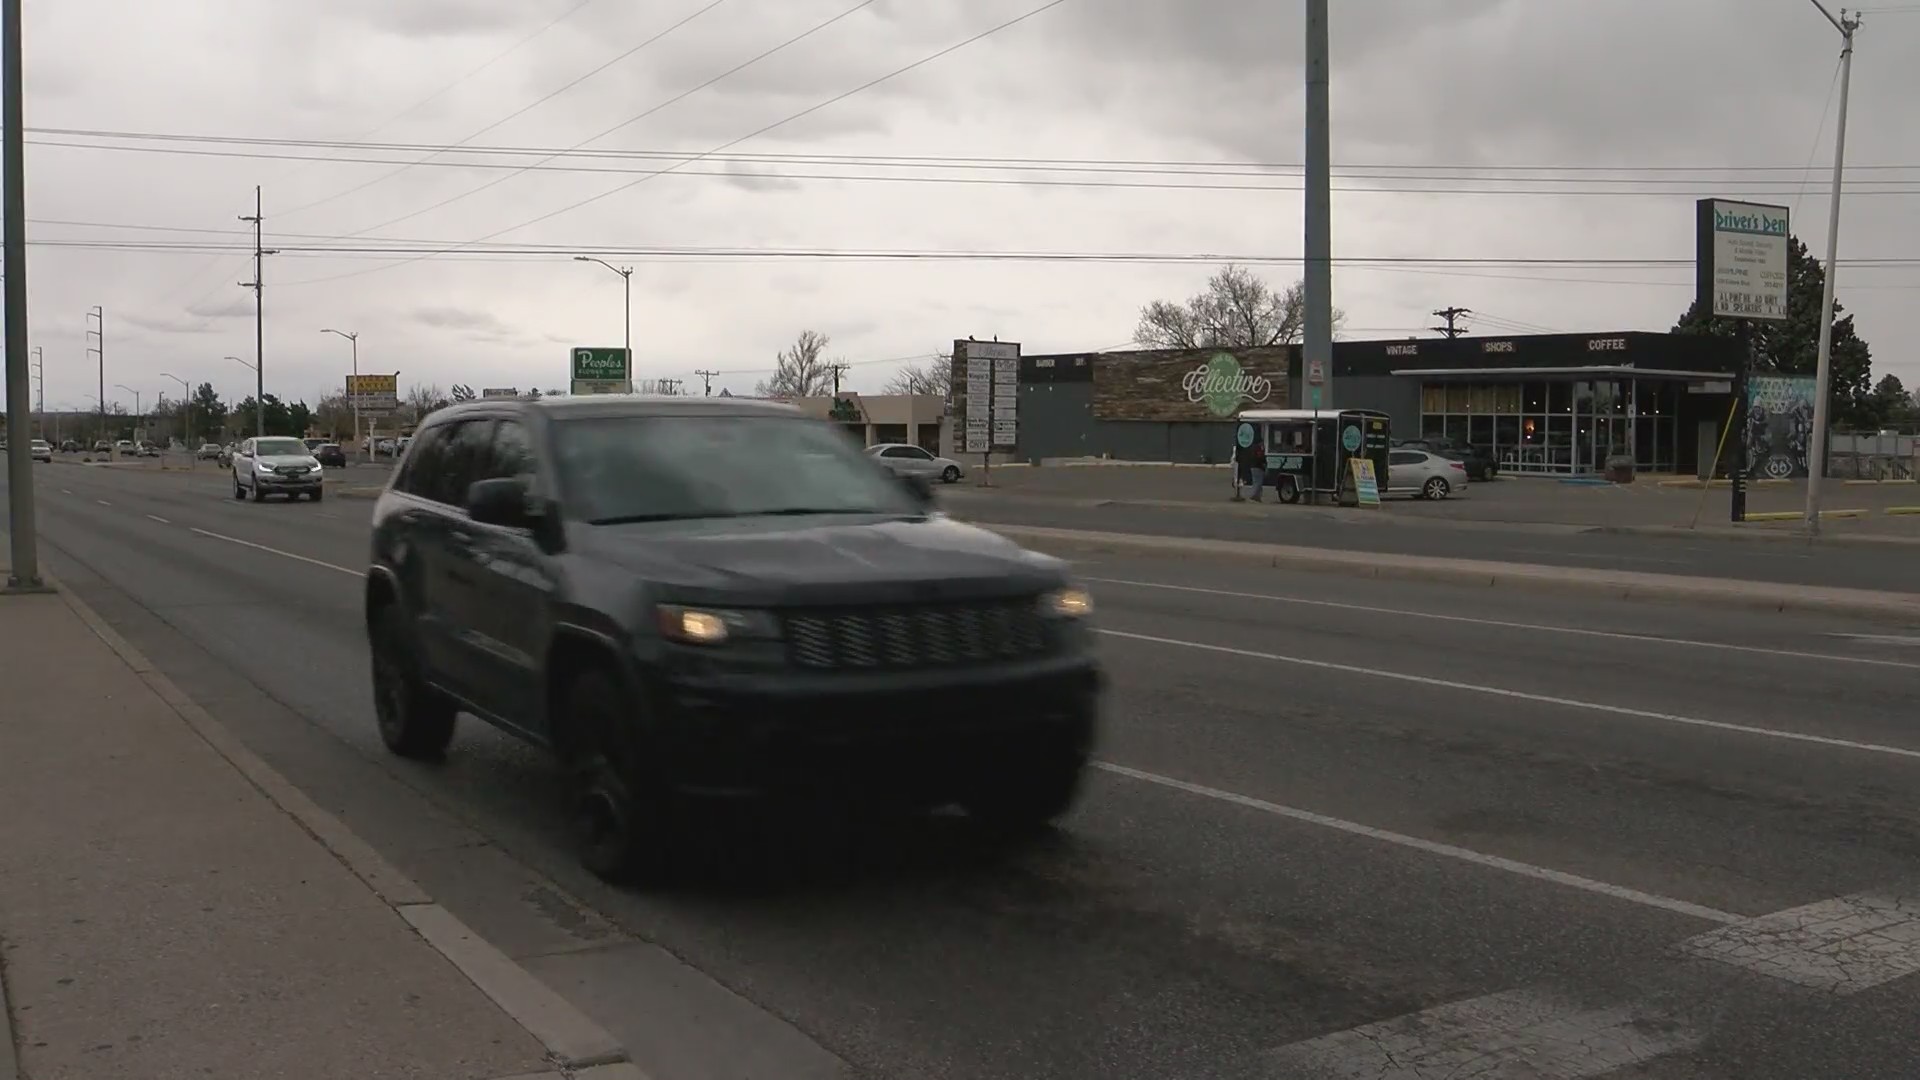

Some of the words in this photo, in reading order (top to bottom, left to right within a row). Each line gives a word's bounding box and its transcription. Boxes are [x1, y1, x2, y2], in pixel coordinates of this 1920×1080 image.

[1714, 208, 1758, 229] Driver's
[1762, 213, 1786, 233] Den
[1386, 345, 1418, 355] VINTAGE
[1485, 341, 1513, 352] SHOPS
[1588, 339, 1625, 351] COFFEE
[578, 350, 625, 368] Peoples
[1182, 364, 1272, 403] Collective
